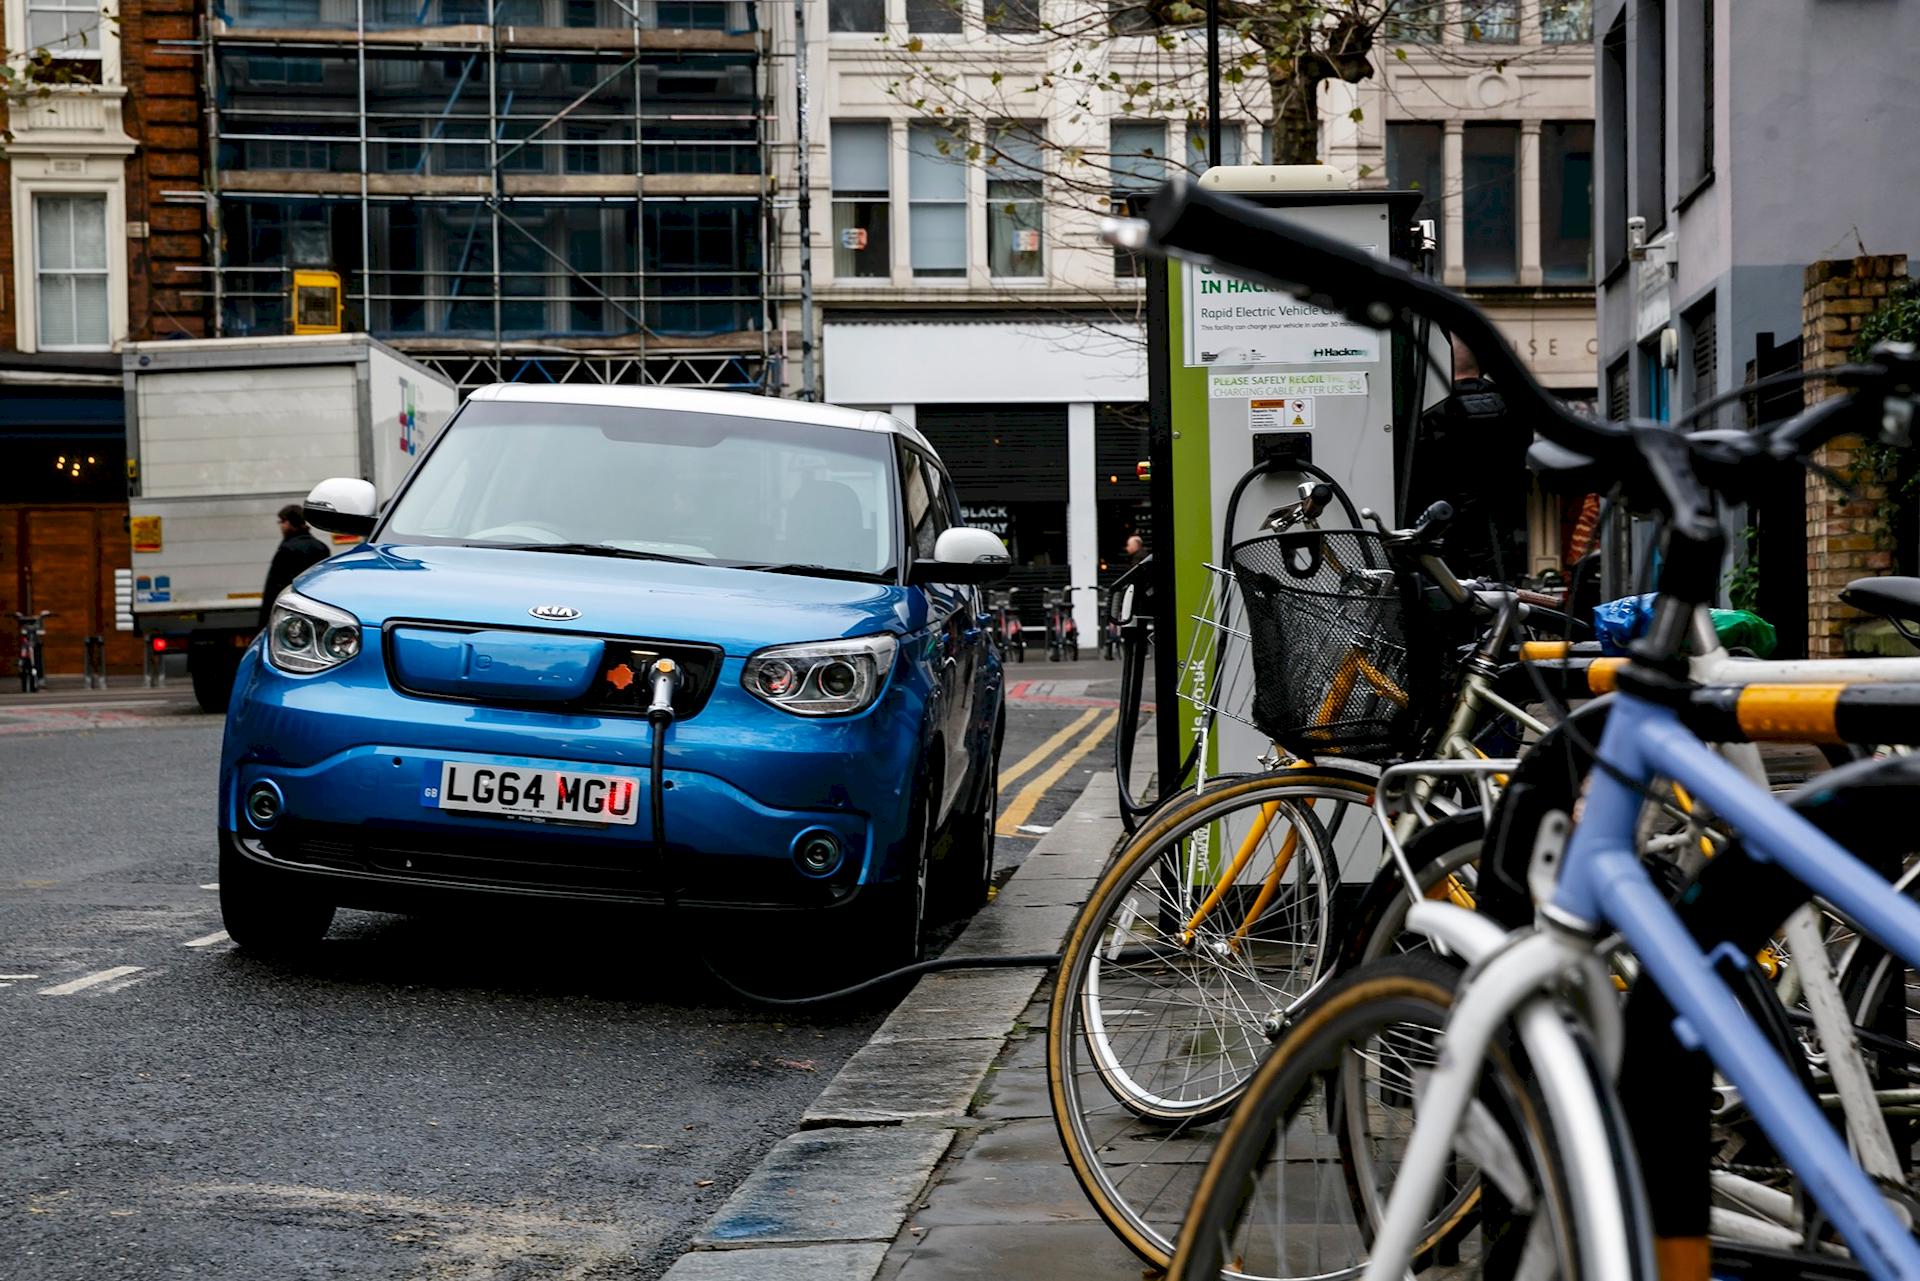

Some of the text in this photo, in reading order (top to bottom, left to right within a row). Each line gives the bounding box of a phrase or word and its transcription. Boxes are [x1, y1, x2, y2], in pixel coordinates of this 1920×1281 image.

[1201, 280, 1221, 294] IN
[1201, 308, 1232, 320] Rapid
[1236, 307, 1276, 317] Electric
[1279, 306, 1319, 316] Vehicle
[1214, 377, 1249, 385] PLEASE
[1251, 376, 1286, 385] SAFELY
[1289, 375, 1325, 384] RECOIL
[1214, 385, 1344, 397] CHARGING CABLE AFTER USE
[960, 506, 1007, 518] BLACK
[536, 605, 574, 617] KIA
[424, 787, 438, 798] GB
[446, 766, 633, 816] LG64 MGU
